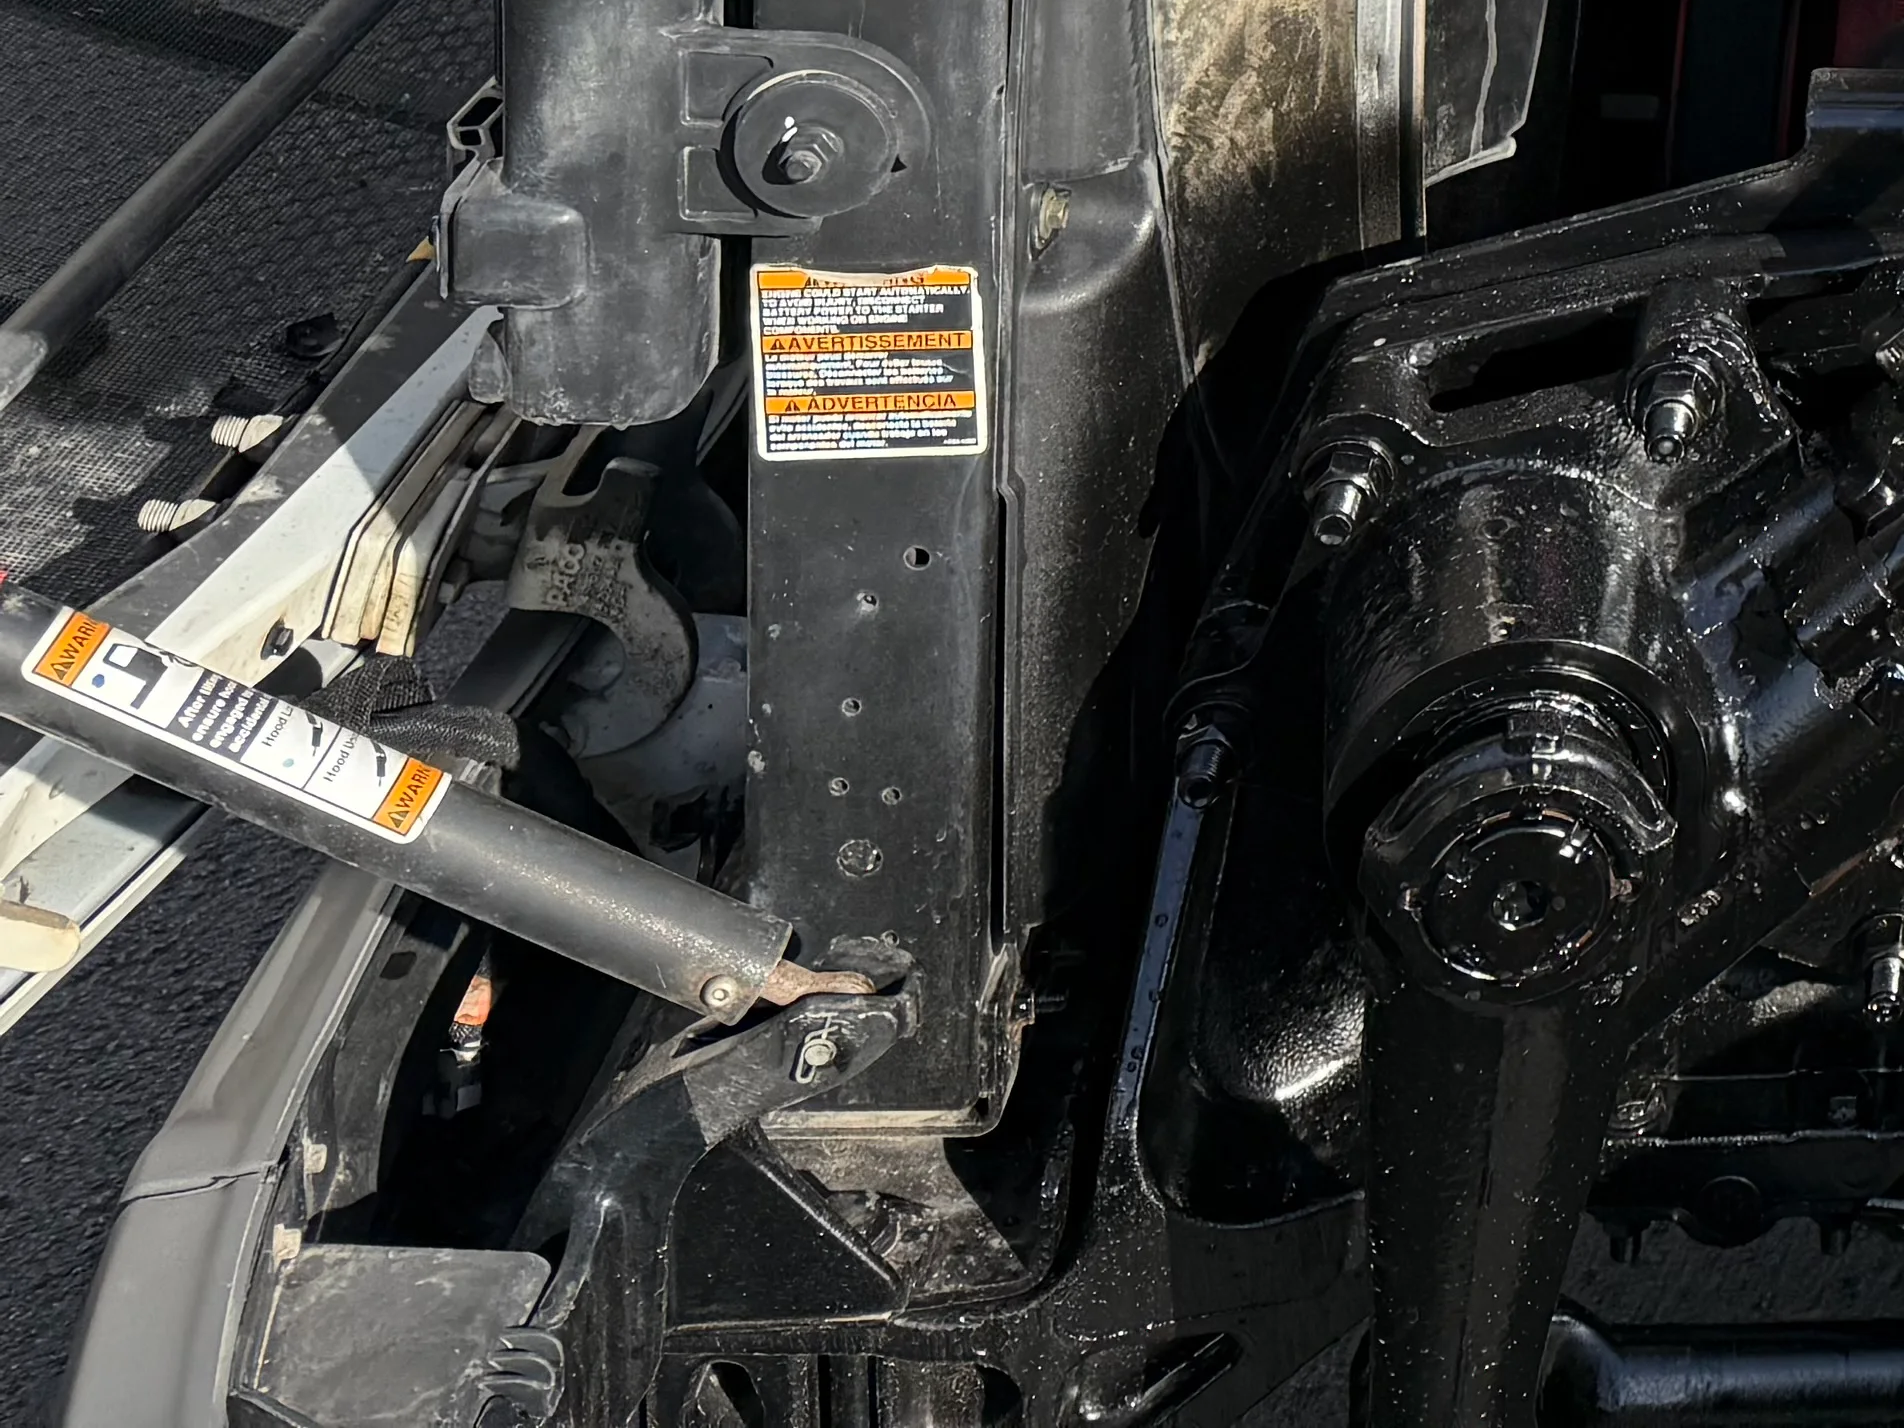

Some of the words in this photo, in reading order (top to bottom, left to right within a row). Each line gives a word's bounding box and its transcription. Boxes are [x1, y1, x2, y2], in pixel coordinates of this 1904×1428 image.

[788, 332, 966, 351] AVERTISSEMENT
[807, 394, 957, 411] ADVERTENCIA
[177, 688, 207, 730] After
[192, 697, 226, 742] ensure
[209, 694, 248, 749] engaged
[261, 714, 287, 747] Hood
[325, 749, 350, 782] Hood
